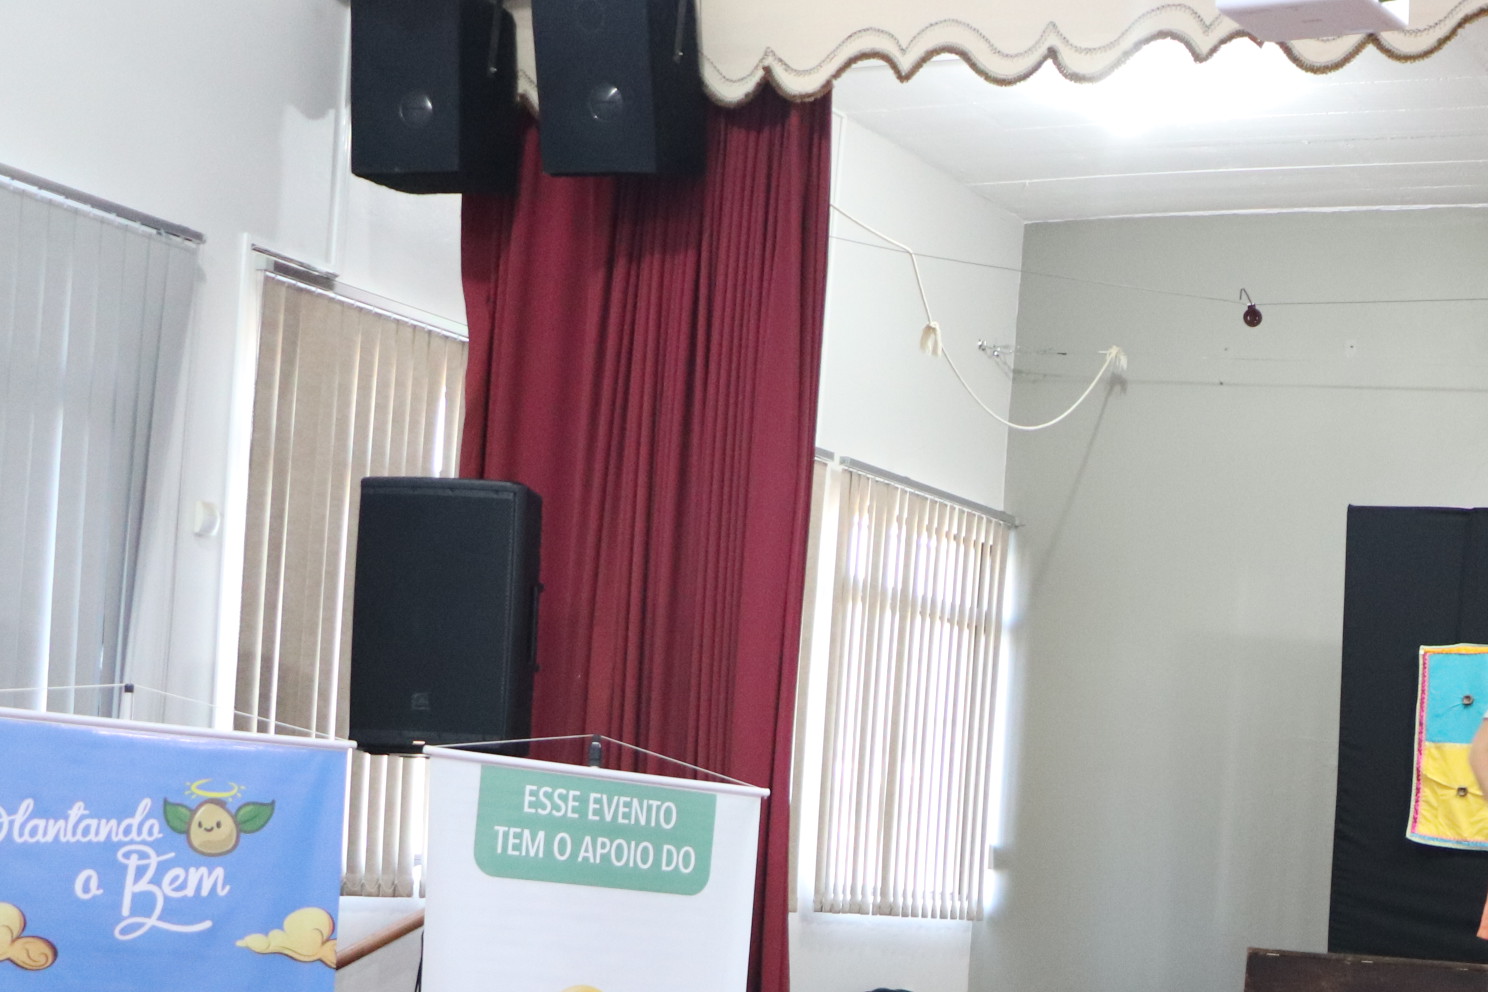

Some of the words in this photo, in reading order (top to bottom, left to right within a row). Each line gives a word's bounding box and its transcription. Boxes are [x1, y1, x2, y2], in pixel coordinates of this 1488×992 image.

[523, 784, 581, 818] ESSE
[588, 792, 678, 830] EVENTO
[494, 825, 546, 859] TEM
[553, 832, 573, 862] O
[578, 835, 655, 870] APOIO
[661, 844, 697, 874] DO
[74, 868, 104, 900] o
[114, 844, 231, 941] Bem
